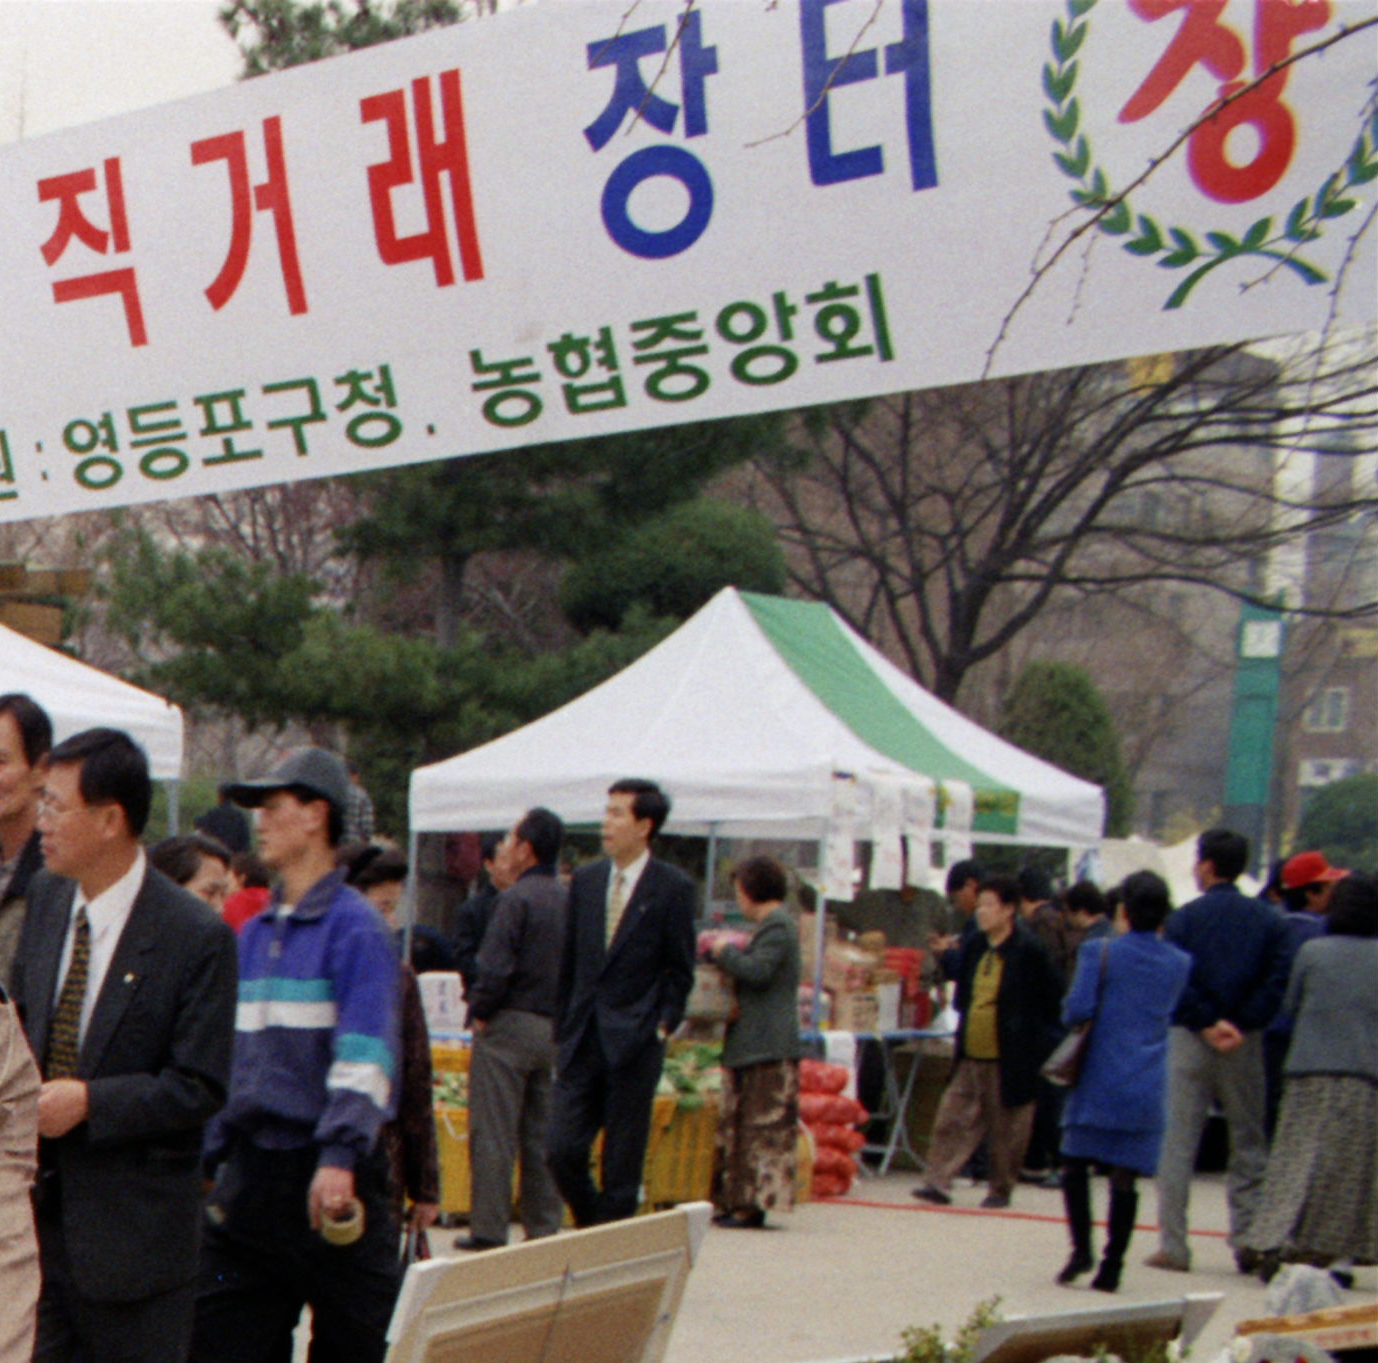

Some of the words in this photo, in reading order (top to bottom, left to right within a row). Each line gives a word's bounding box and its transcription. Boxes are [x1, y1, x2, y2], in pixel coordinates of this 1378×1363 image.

[37, 68, 485, 347] 직거래
[583, 0, 938, 259] 장터
[1116, 0, 1332, 203] 장
